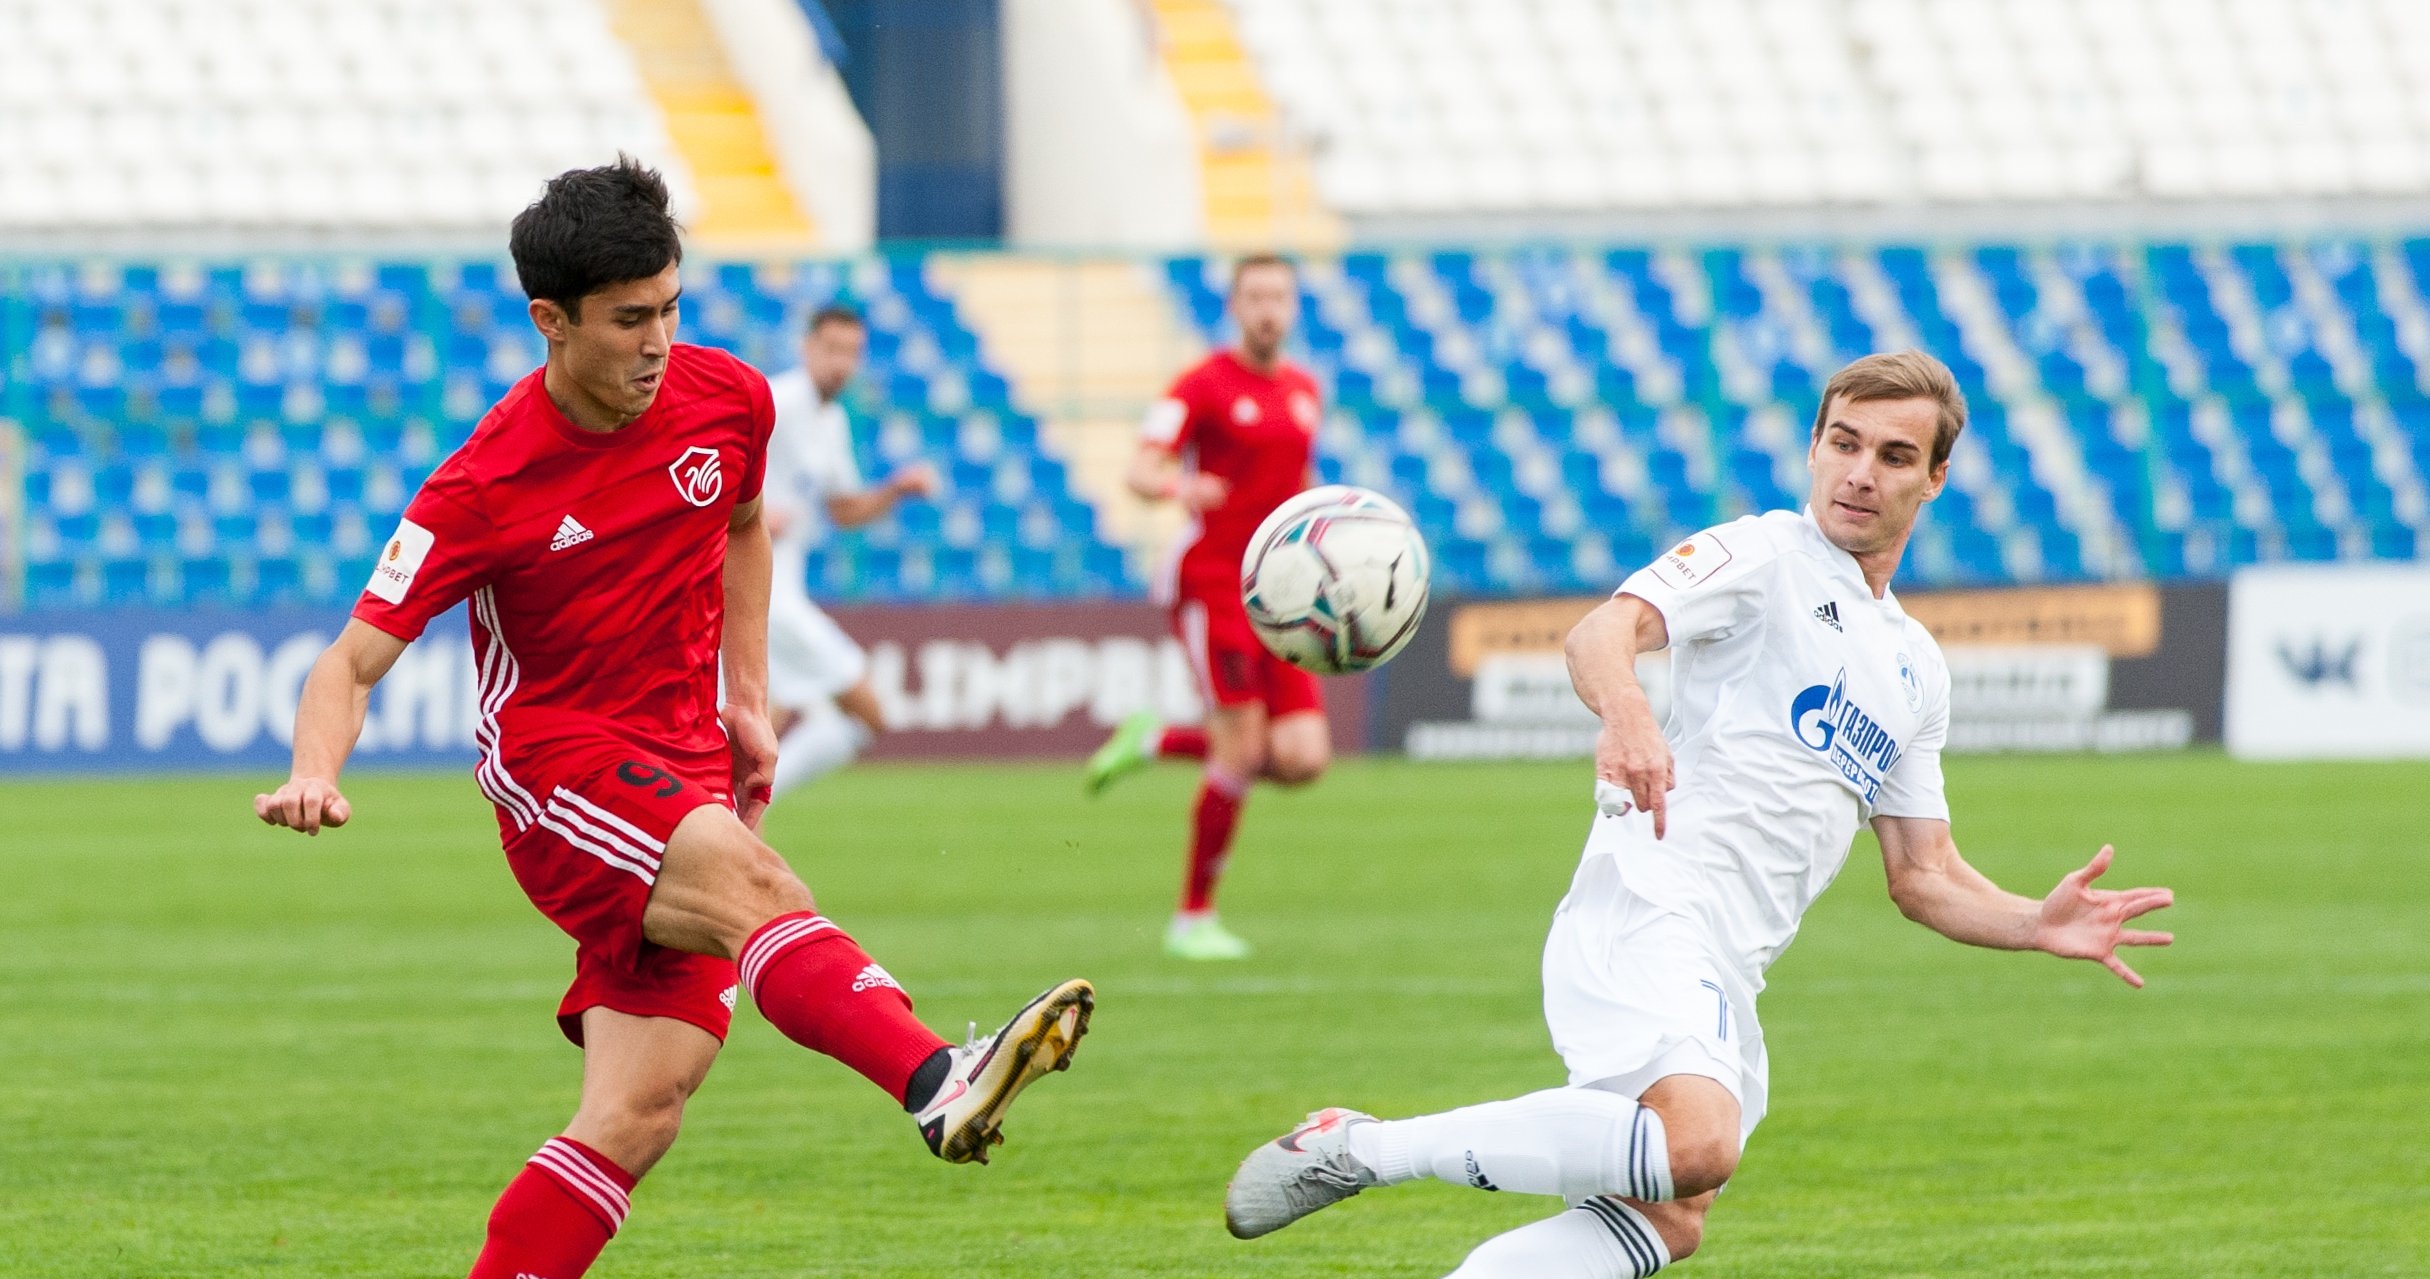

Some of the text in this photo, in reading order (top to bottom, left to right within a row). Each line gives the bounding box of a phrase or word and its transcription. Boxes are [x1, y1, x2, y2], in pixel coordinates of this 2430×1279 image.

[550, 529, 594, 551] adidas
[1813, 609, 1843, 633] adidas
[617, 760, 683, 798] 9
